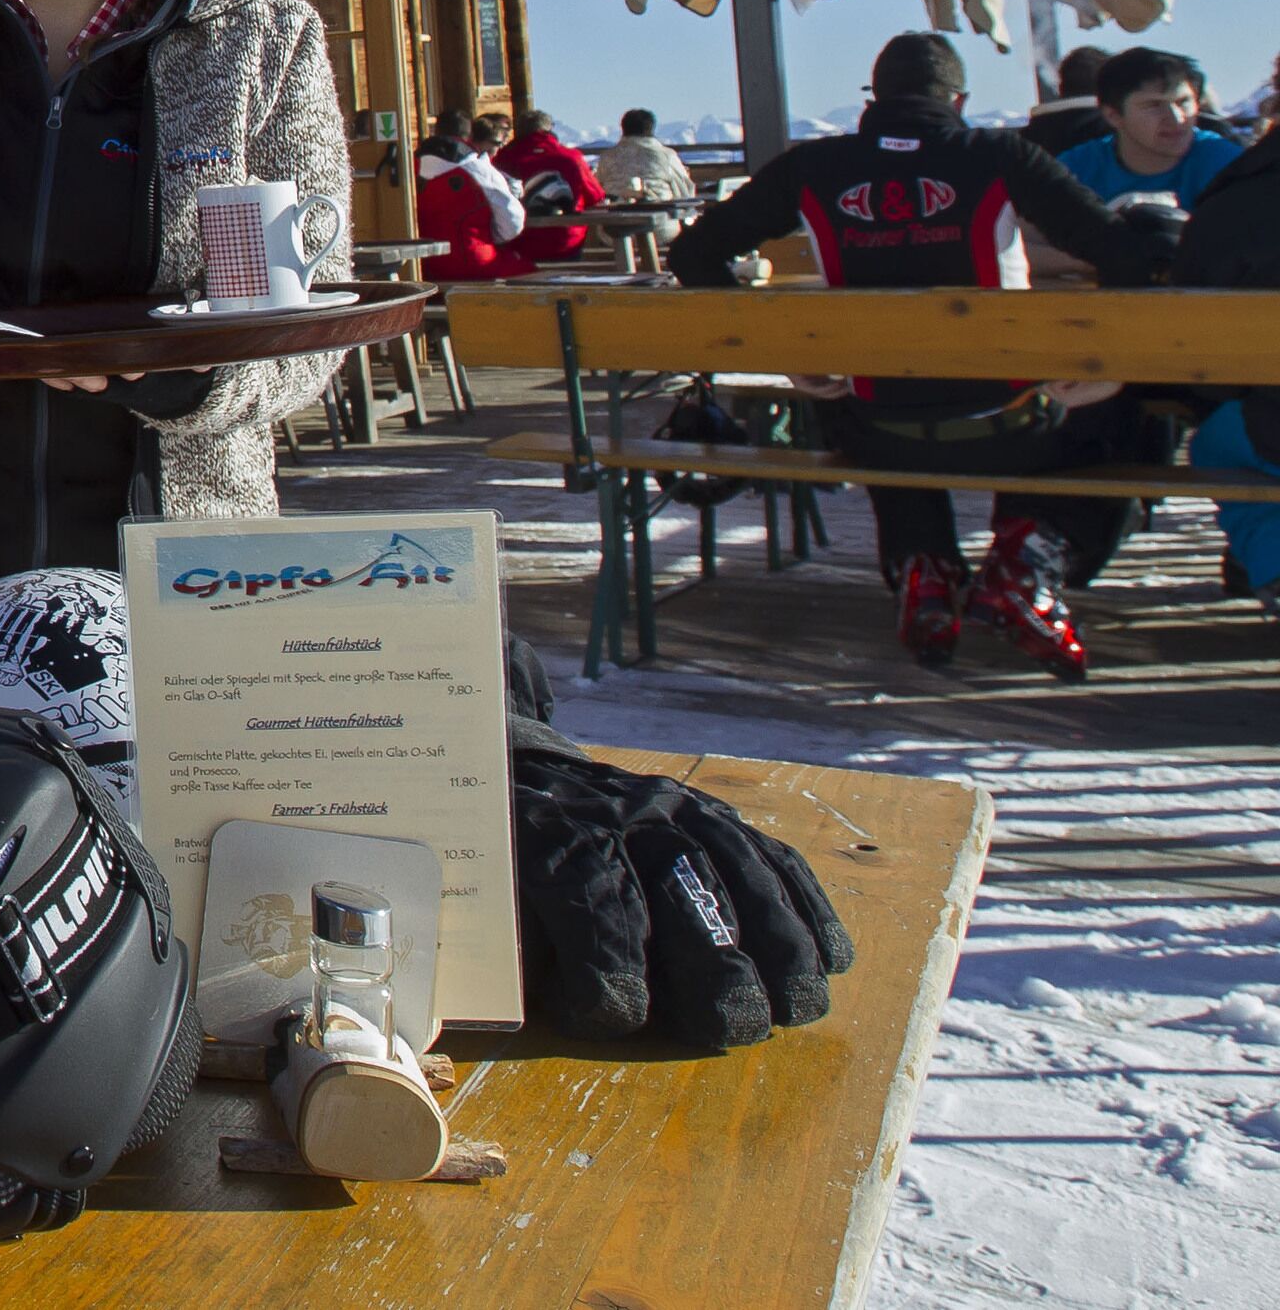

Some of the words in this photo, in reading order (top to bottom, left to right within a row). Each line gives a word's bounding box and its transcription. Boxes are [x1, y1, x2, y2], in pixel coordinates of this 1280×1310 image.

[838, 182, 874, 221] H
[881, 180, 913, 221] &
[917, 177, 956, 218] N
[907, 223, 962, 244] Team
[282, 637, 382, 652] Hüttenfrühstück
[35, 671, 64, 697] SKI
[164, 674, 198, 686] Rührei
[200, 674, 224, 685] oder
[227, 673, 270, 687] Spiegelei
[273, 673, 291, 683] mit
[329, 672, 351, 682] eine
[353, 670, 385, 685] große
[388, 671, 414, 682] Tasse
[165, 693, 180, 702] ein
[183, 690, 205, 702] Glas
[207, 688, 241, 700] O-Saft
[245, 716, 301, 730] Gourmet
[304, 713, 404, 729] Hüttenfrühstück
[168, 749, 222, 762] Gemischte
[260, 748, 312, 762] gekochtes
[331, 746, 364, 761] jeweils
[367, 748, 383, 758] ein
[386, 746, 408, 758] Glas
[410, 745, 446, 757] O-Saft
[170, 766, 189, 776] und
[170, 780, 201, 794] große
[204, 781, 229, 791] Tasse
[232, 778, 265, 791] Kaffee
[267, 779, 291, 790] oder
[294, 779, 312, 789] Tee
[329, 801, 388, 816] Frühstück
[175, 854, 185, 863] in
